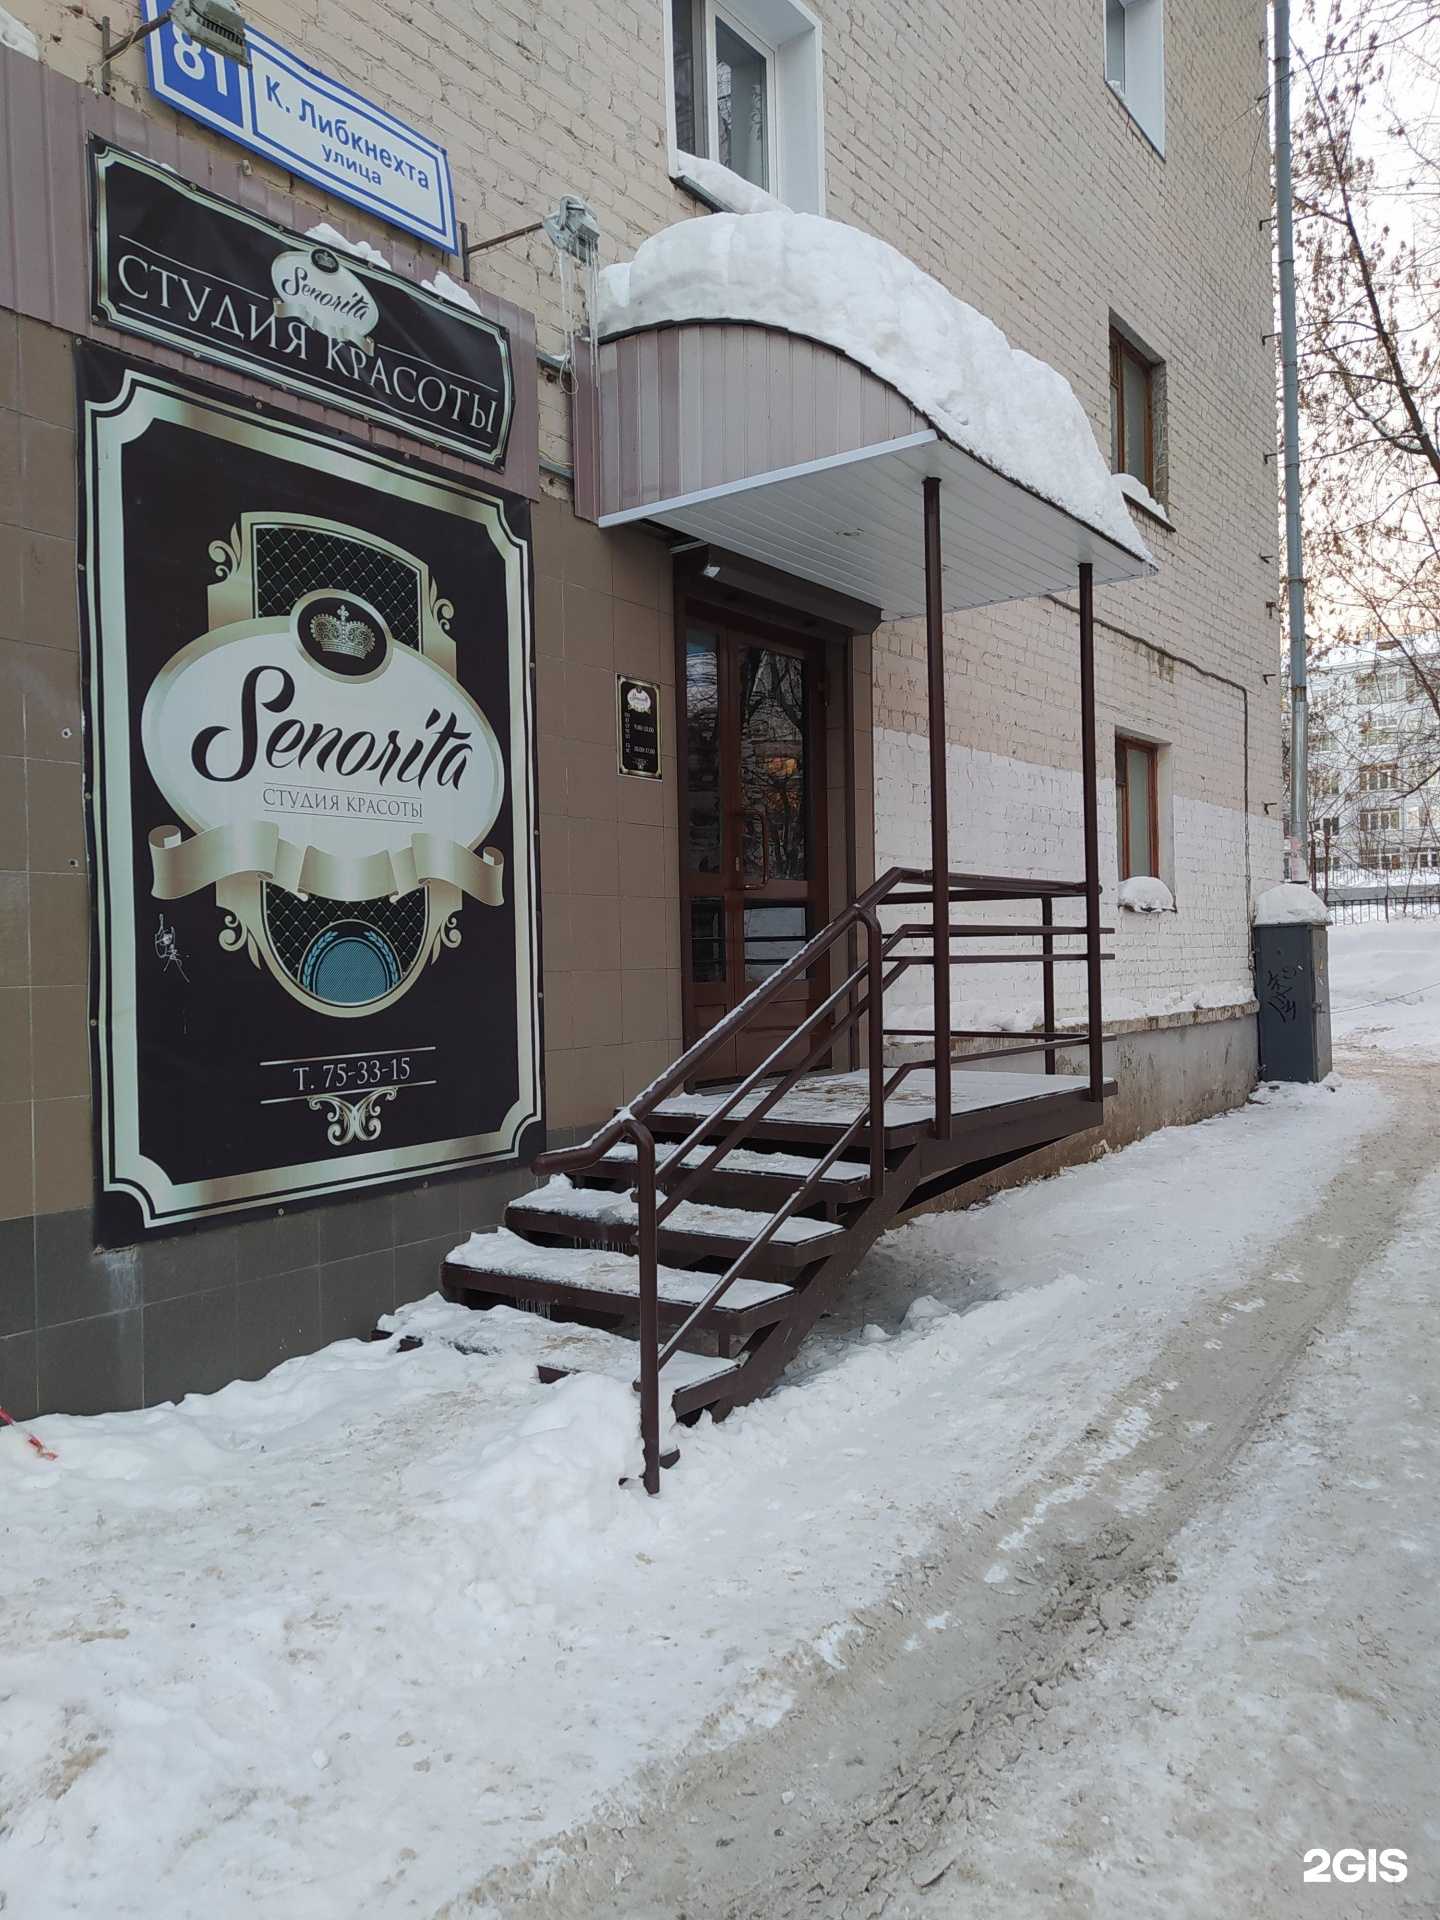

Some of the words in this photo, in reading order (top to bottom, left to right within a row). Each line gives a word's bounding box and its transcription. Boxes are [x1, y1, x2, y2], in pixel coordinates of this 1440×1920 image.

[172, 22, 228, 96] 81
[265, 74, 292, 113] К.
[299, 101, 430, 190] Либкнехта
[321, 144, 382, 186] улица
[281, 266, 370, 321] Senorita
[118, 254, 308, 360] СТУДИЯ
[325, 335, 498, 434] КРАСОТЫ
[191, 665, 473, 790] Senorita
[262, 788, 339, 811] СТУДИЯ
[346, 796, 424, 818] КРАСОТЫ
[322, 1057, 411, 1087] 75-33-15
